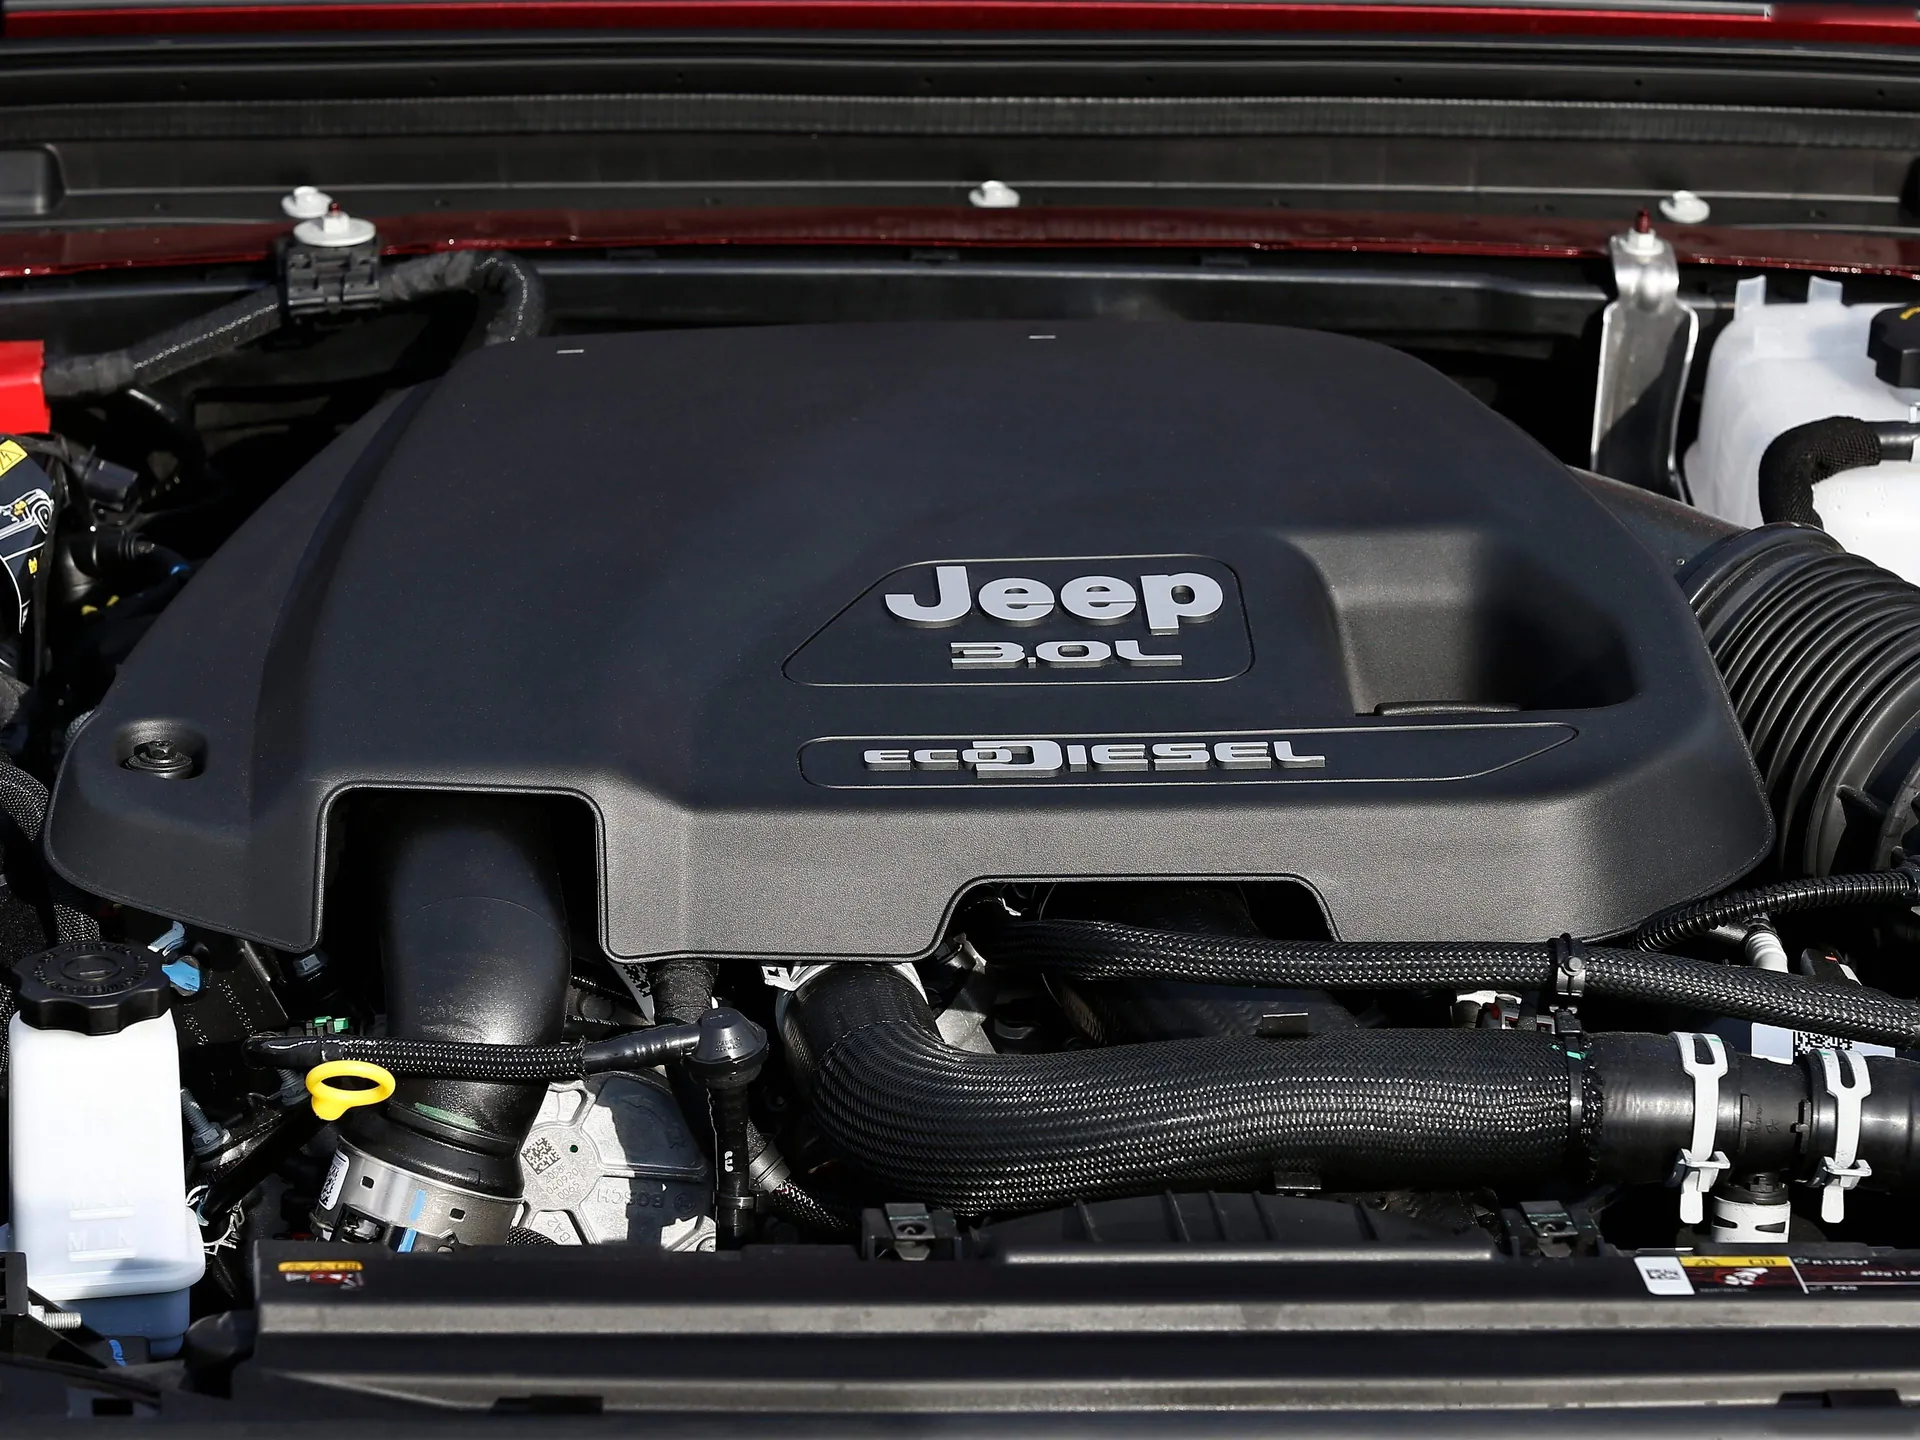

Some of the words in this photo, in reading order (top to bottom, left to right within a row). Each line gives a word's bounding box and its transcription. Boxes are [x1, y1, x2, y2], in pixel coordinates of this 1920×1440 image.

[884, 565, 1224, 635] Jeep
[950, 640, 1183, 669] 3.0L
[863, 740, 1326, 779] ECODIESEL
[543, 1162, 567, 1184] 2058F
[546, 1167, 580, 1195] 040920
[557, 1180, 580, 1200] 0065
[596, 1188, 666, 1209] BOSCH
